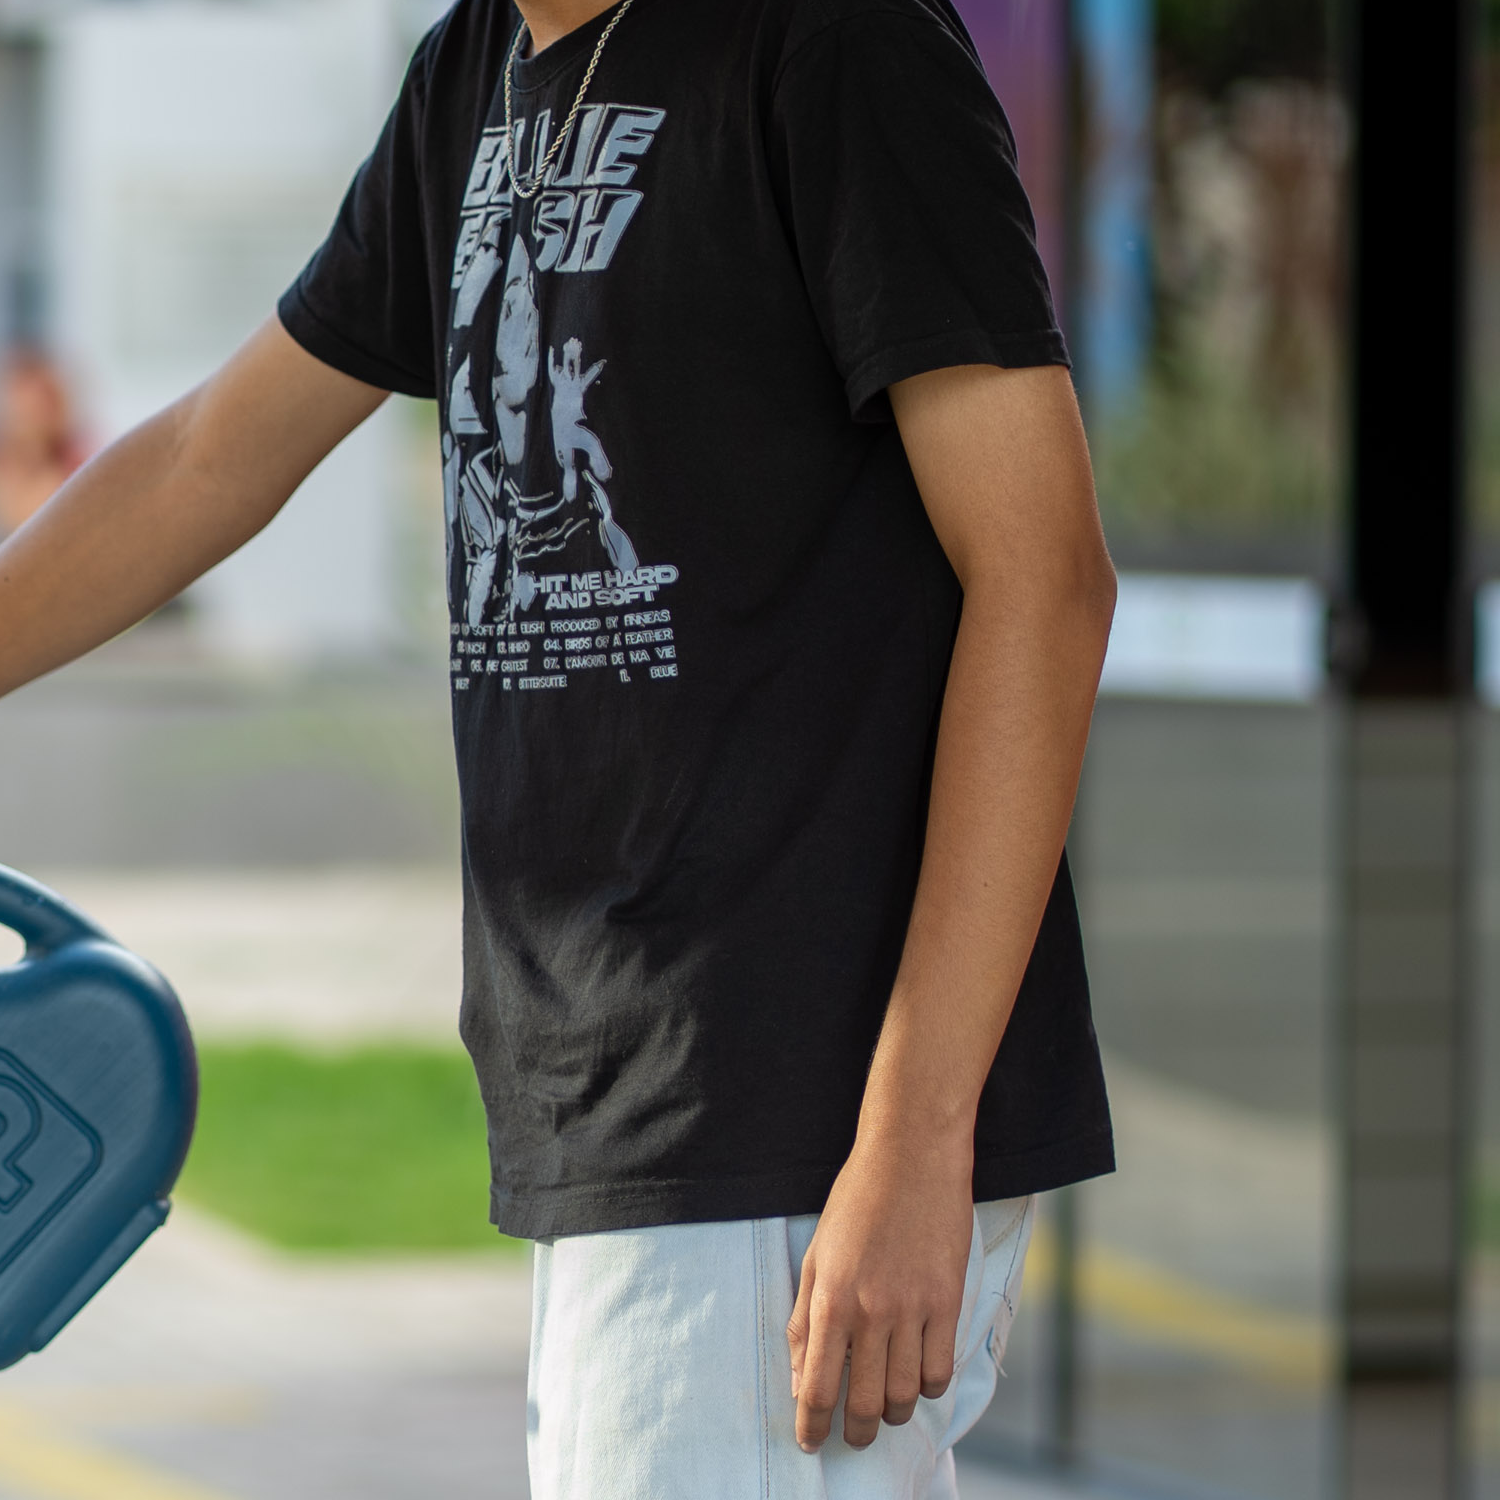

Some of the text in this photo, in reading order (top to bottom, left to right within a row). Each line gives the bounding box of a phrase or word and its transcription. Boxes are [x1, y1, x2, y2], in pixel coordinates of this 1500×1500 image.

[533, 565, 679, 593] HIT ME HARD
[545, 584, 660, 610] AND SOFT
[550, 618, 601, 634] PRODUCED
[605, 616, 619, 630] BY
[564, 636, 593, 652] BIRDS
[595, 635, 610, 649] OF
[612, 632, 622, 647] A
[610, 652, 626, 666] DE
[629, 649, 651, 664] MA
[654, 645, 677, 660] VIE
[649, 663, 679, 679] BLUE
